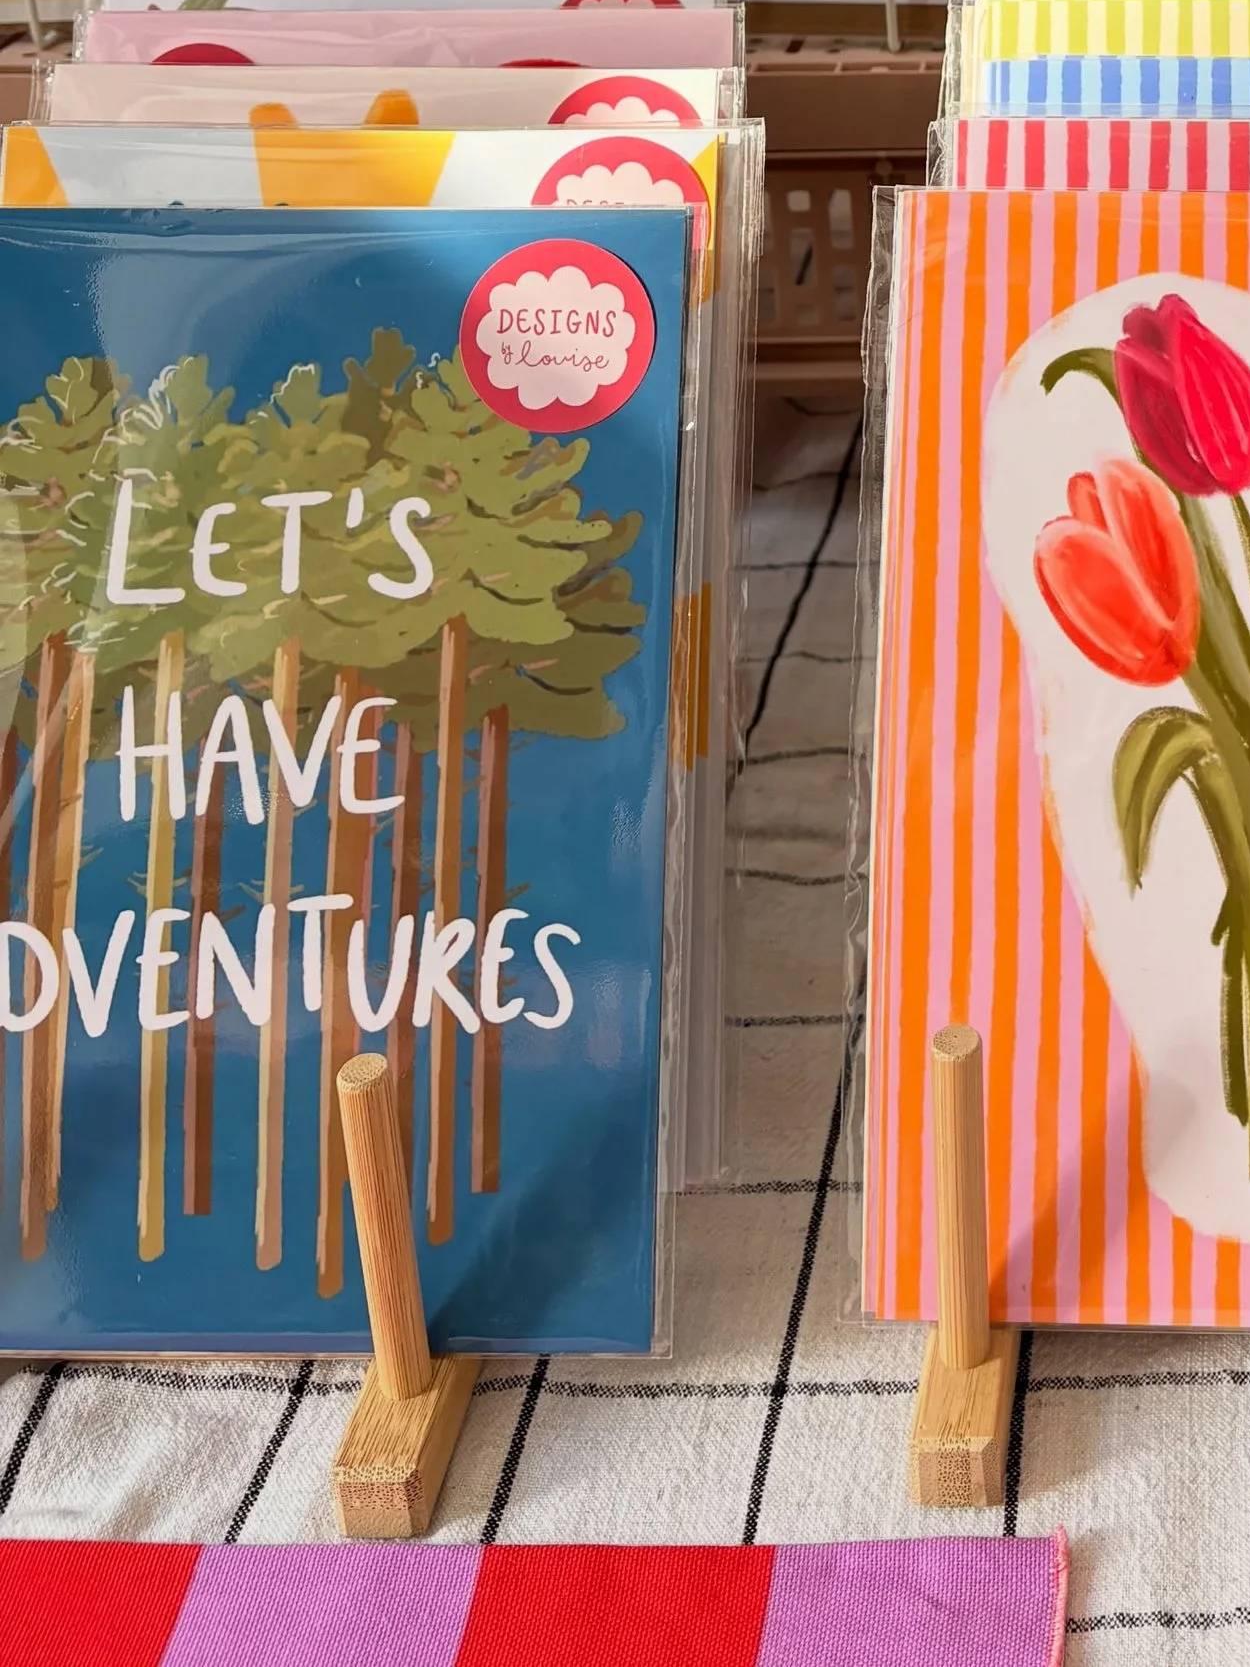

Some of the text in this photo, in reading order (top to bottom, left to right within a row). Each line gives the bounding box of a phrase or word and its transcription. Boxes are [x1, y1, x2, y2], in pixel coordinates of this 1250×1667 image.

[497, 308, 617, 338] DESIGNS
[501, 339, 610, 372] by louise
[106, 478, 434, 605] LET'S
[115, 684, 405, 825] HAVE
